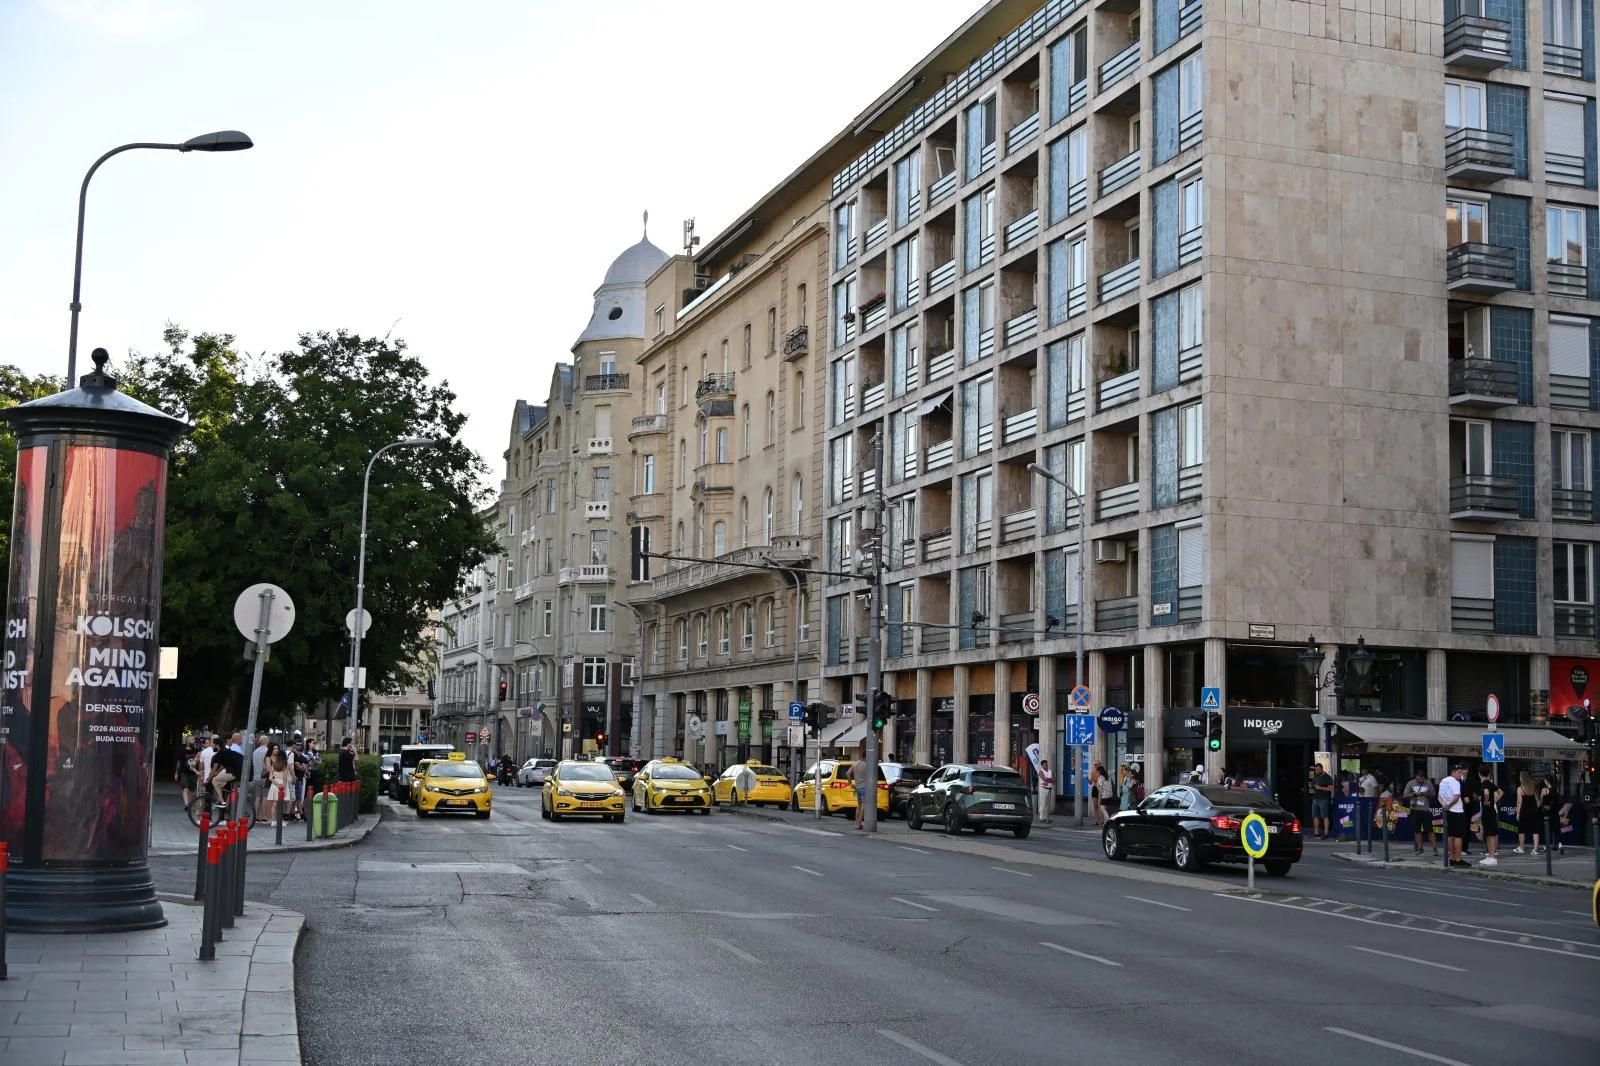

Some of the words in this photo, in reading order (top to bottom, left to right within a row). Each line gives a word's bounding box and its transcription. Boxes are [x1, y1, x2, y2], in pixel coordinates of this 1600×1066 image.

[76, 610, 154, 640] KÖLSCH
[89, 647, 146, 669] MIND
[65, 667, 153, 690] AGAINST
[85, 703, 123, 713] DENES
[123, 704, 144, 714] TOTH
[108, 725, 134, 733] AUGUST
[1243, 719, 1283, 729] INDIGO
